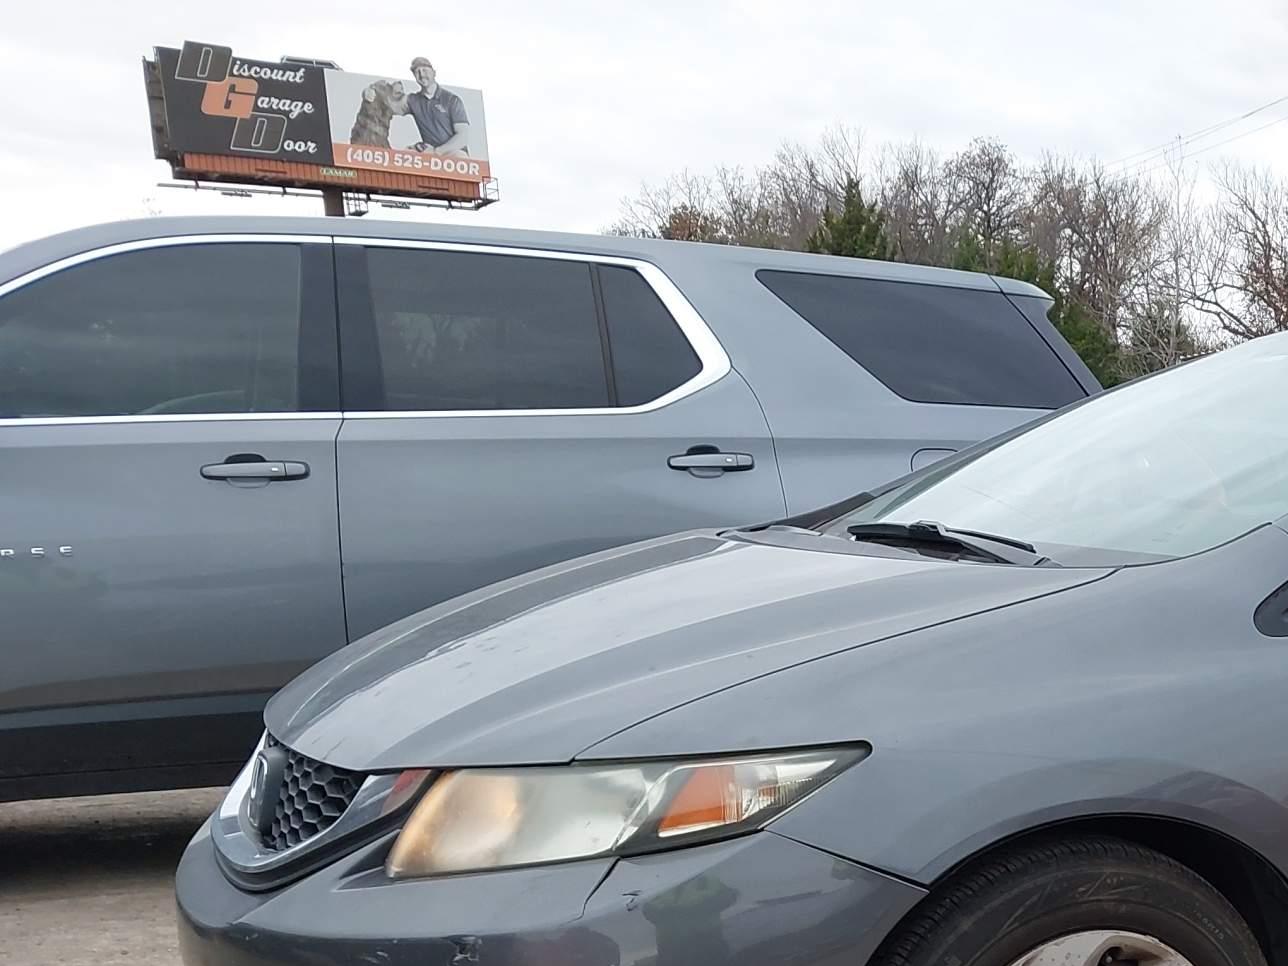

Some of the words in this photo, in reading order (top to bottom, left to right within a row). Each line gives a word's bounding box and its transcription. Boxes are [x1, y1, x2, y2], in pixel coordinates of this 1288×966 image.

[175, 40, 304, 84] Discount
[200, 76, 315, 119] Garage
[230, 113, 319, 154] Door
[346, 147, 390, 168] (405)
[393, 151, 481, 176] 525-DOOR
